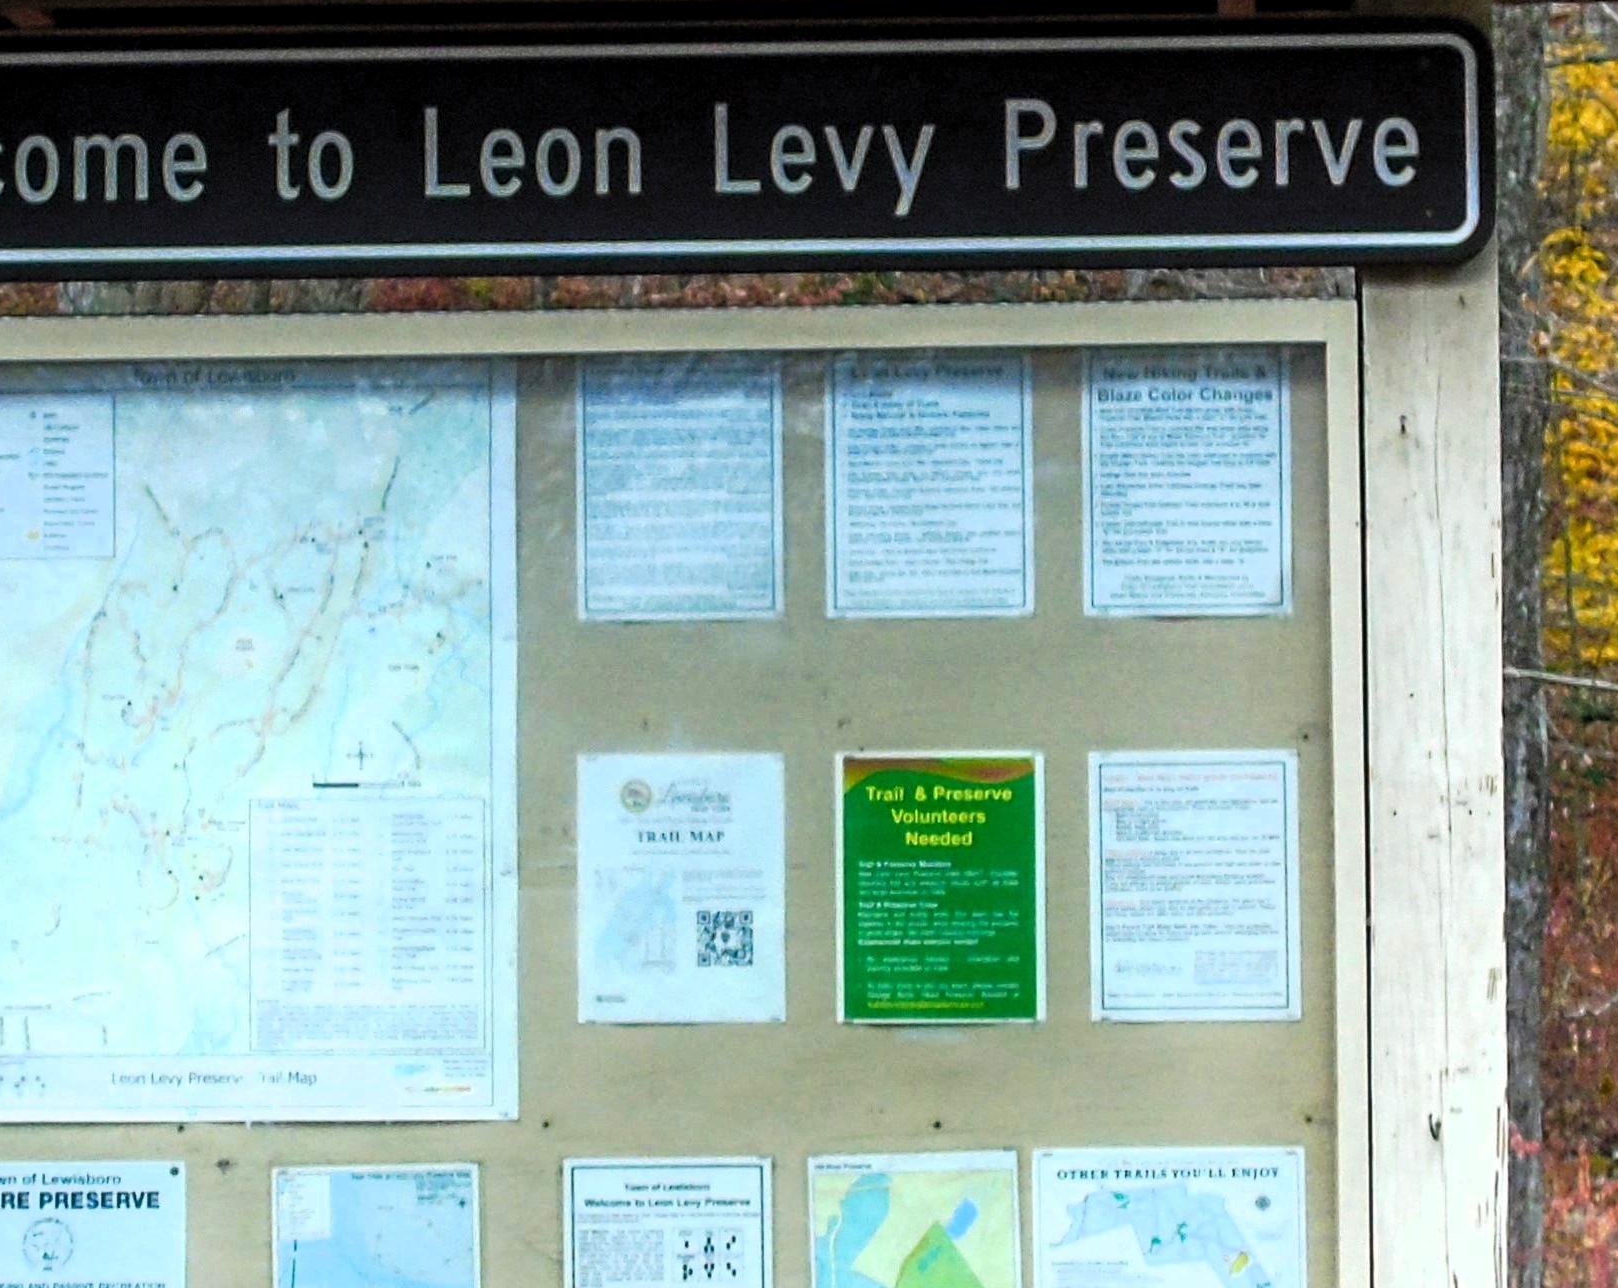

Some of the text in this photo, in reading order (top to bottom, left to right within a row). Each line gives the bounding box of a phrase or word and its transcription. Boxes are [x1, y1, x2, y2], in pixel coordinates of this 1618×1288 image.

[268, 108, 354, 201] to
[424, 105, 642, 199] Leon
[714, 102, 934, 217] Levy
[1004, 98, 1420, 189] Preserve
[1098, 387, 1273, 404] Blaze Color Changes
[865, 785, 1013, 801] Trail & Preserve
[891, 808, 986, 824] Volunteers
[690, 831, 725, 843] MAP
[905, 831, 973, 846] Needed
[150, 1072, 182, 1087] Levy
[287, 1071, 318, 1086] Map
[22, 1172, 37, 1186] of
[42, 1172, 122, 1186] Lewisboro
[1056, 1167, 1279, 1180] OTHER TRAILS YOU'LL ENJOY
[39, 1191, 160, 1210] PRESERVE
[584, 1198, 751, 1208] Welcome to Leon Levy Preserve
